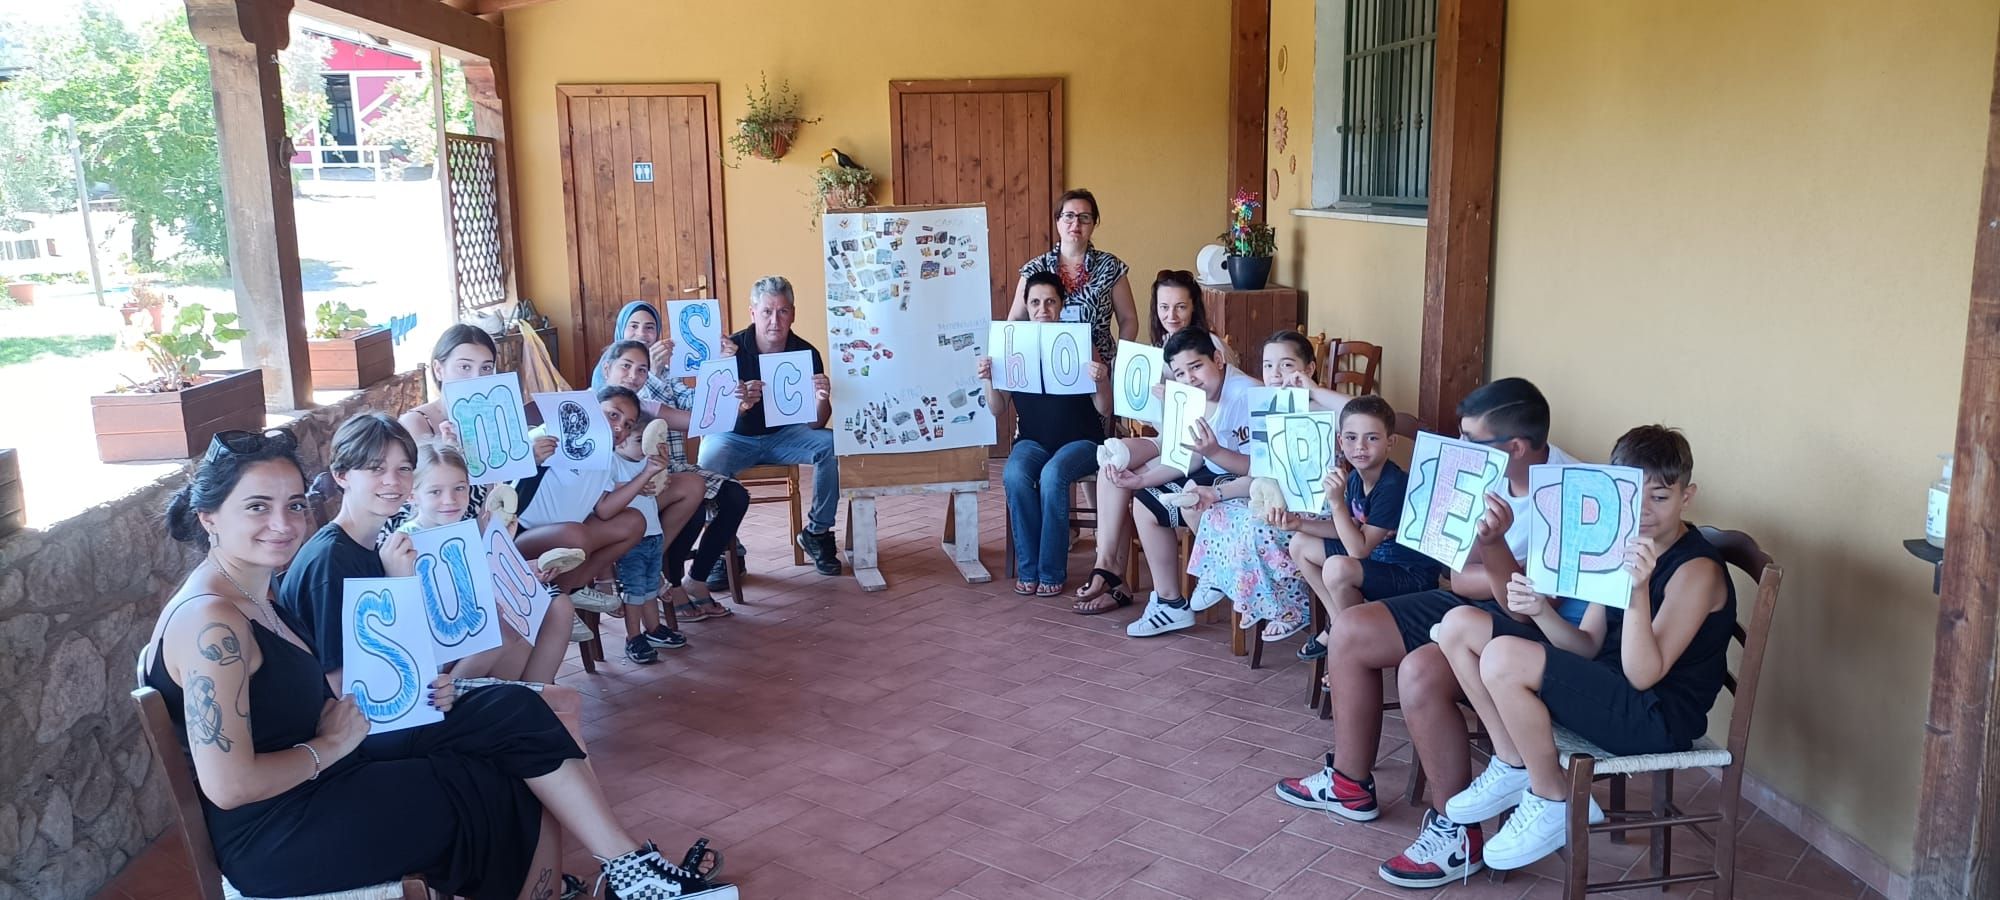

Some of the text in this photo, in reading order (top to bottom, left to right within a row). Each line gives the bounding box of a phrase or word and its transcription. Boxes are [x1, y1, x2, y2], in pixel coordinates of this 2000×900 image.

[699, 369, 737, 429] r
[1004, 324, 1028, 388] h
[452, 384, 529, 477] m
[558, 400, 596, 460] e
[1284, 416, 1323, 510] P
[1418, 442, 1489, 566] E
[1556, 467, 1622, 596] P
